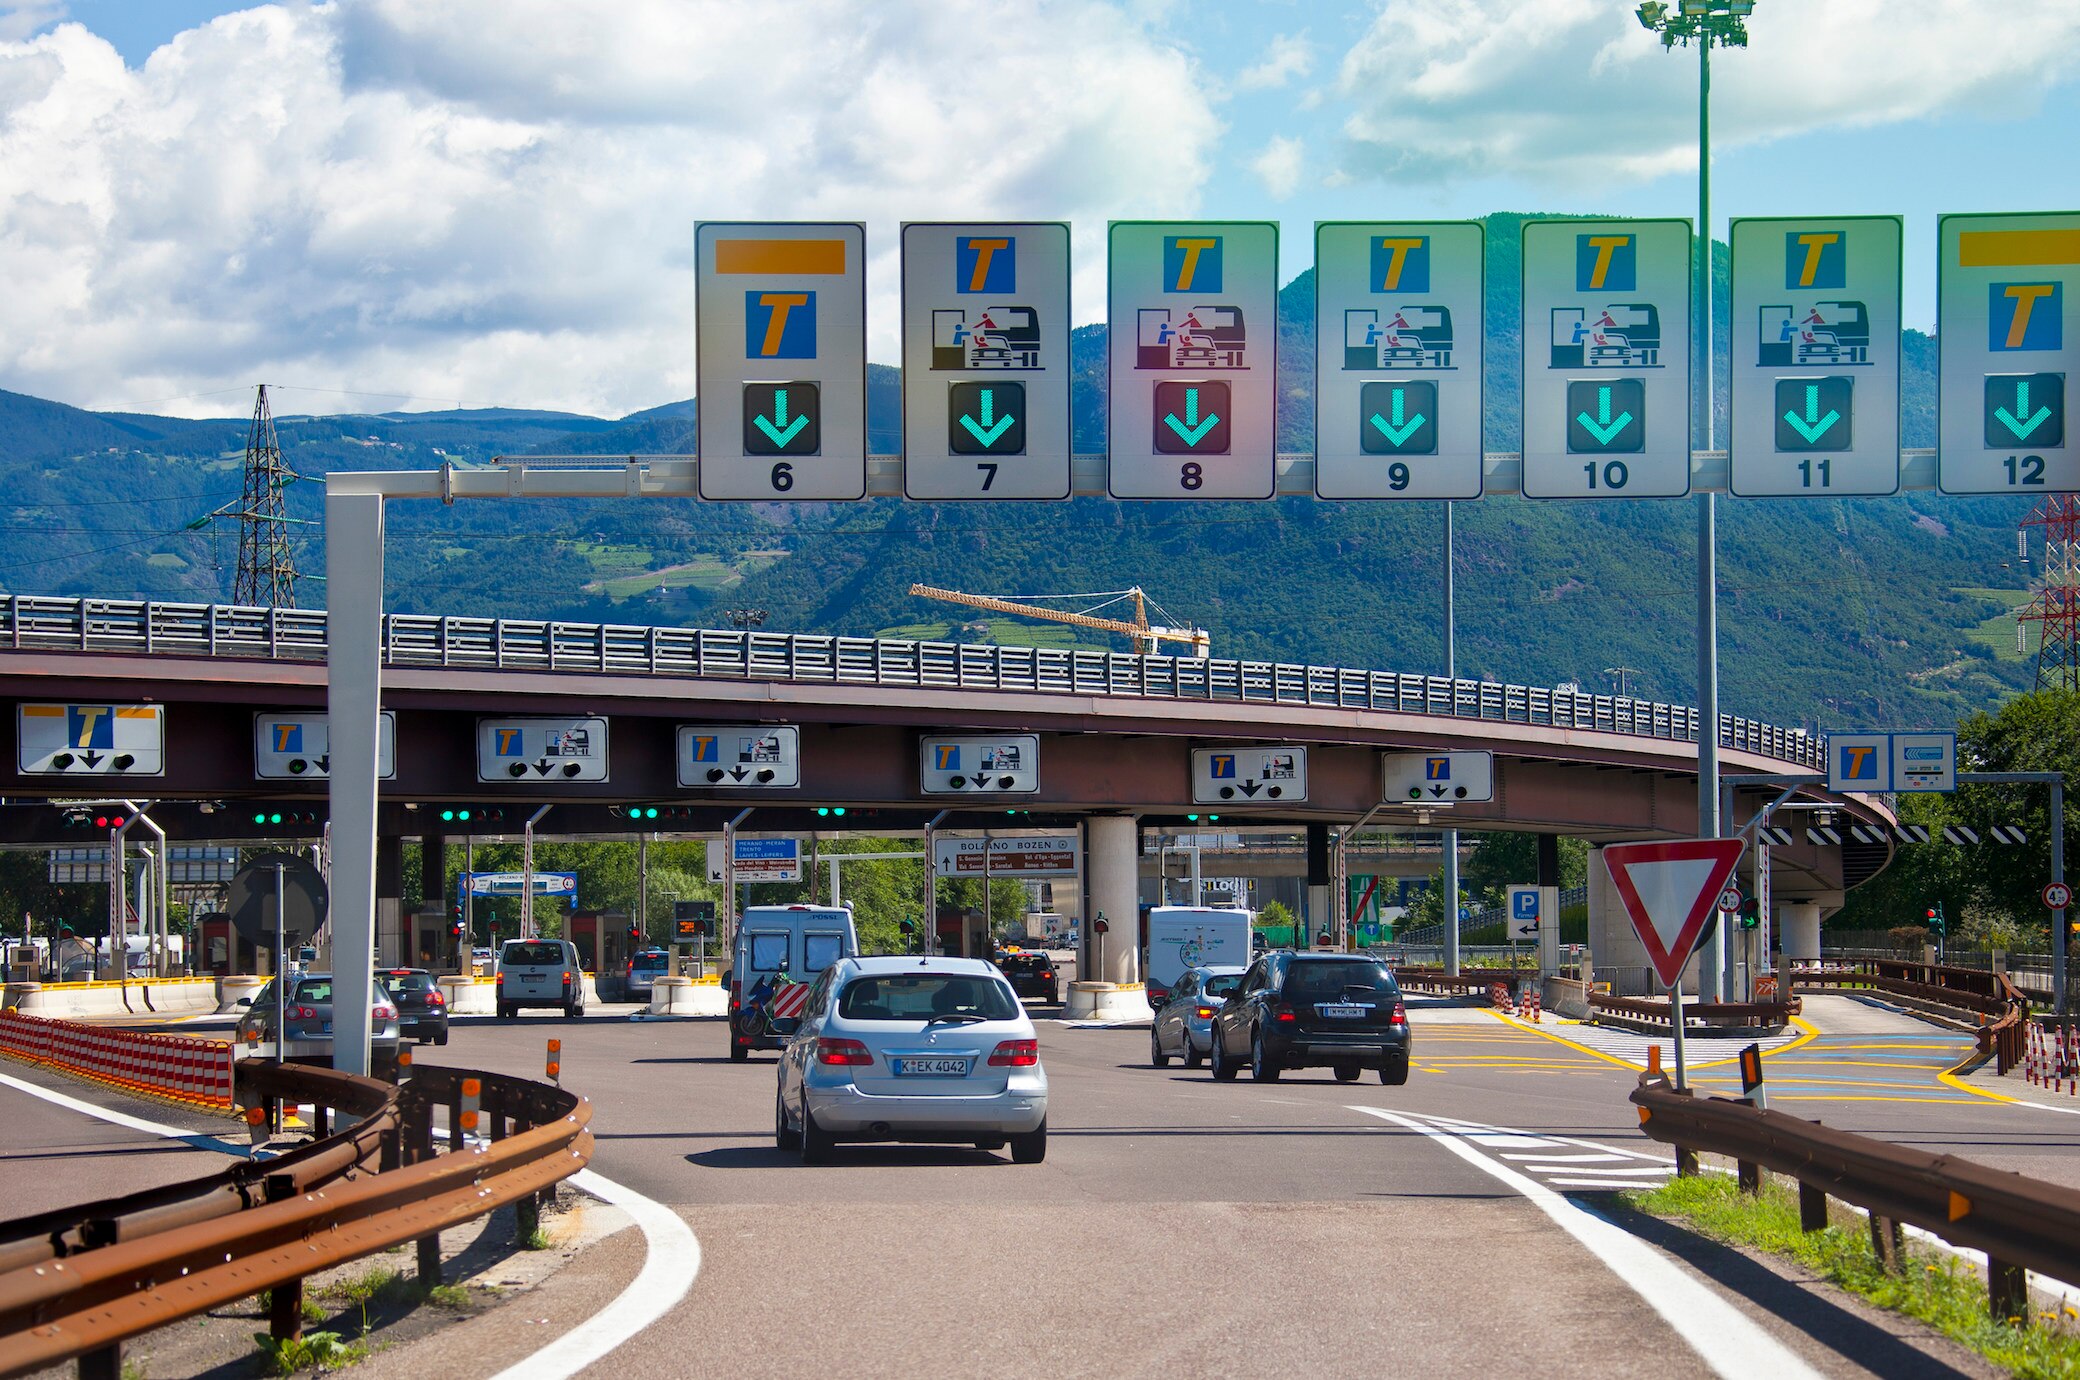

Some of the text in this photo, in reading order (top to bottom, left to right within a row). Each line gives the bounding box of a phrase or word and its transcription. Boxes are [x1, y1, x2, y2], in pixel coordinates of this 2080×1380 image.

[969, 239, 1009, 291] T
[1176, 238, 1216, 290] T
[1383, 238, 1422, 290] T
[1590, 236, 1629, 287] T
[1799, 234, 1838, 286] T
[759, 293, 808, 356] T
[2005, 285, 2054, 348] T
[770, 463, 793, 492] 6
[977, 463, 998, 492] 7
[1180, 462, 1203, 491] 8
[1388, 462, 1410, 491] 9
[1584, 461, 1629, 490] 10
[1798, 460, 1831, 488] 11
[2003, 456, 2045, 485] 12
[1017, 841, 1052, 849] BOZEN
[1521, 894, 1535, 912] P
[902, 1061, 965, 1073] K EK 4042
